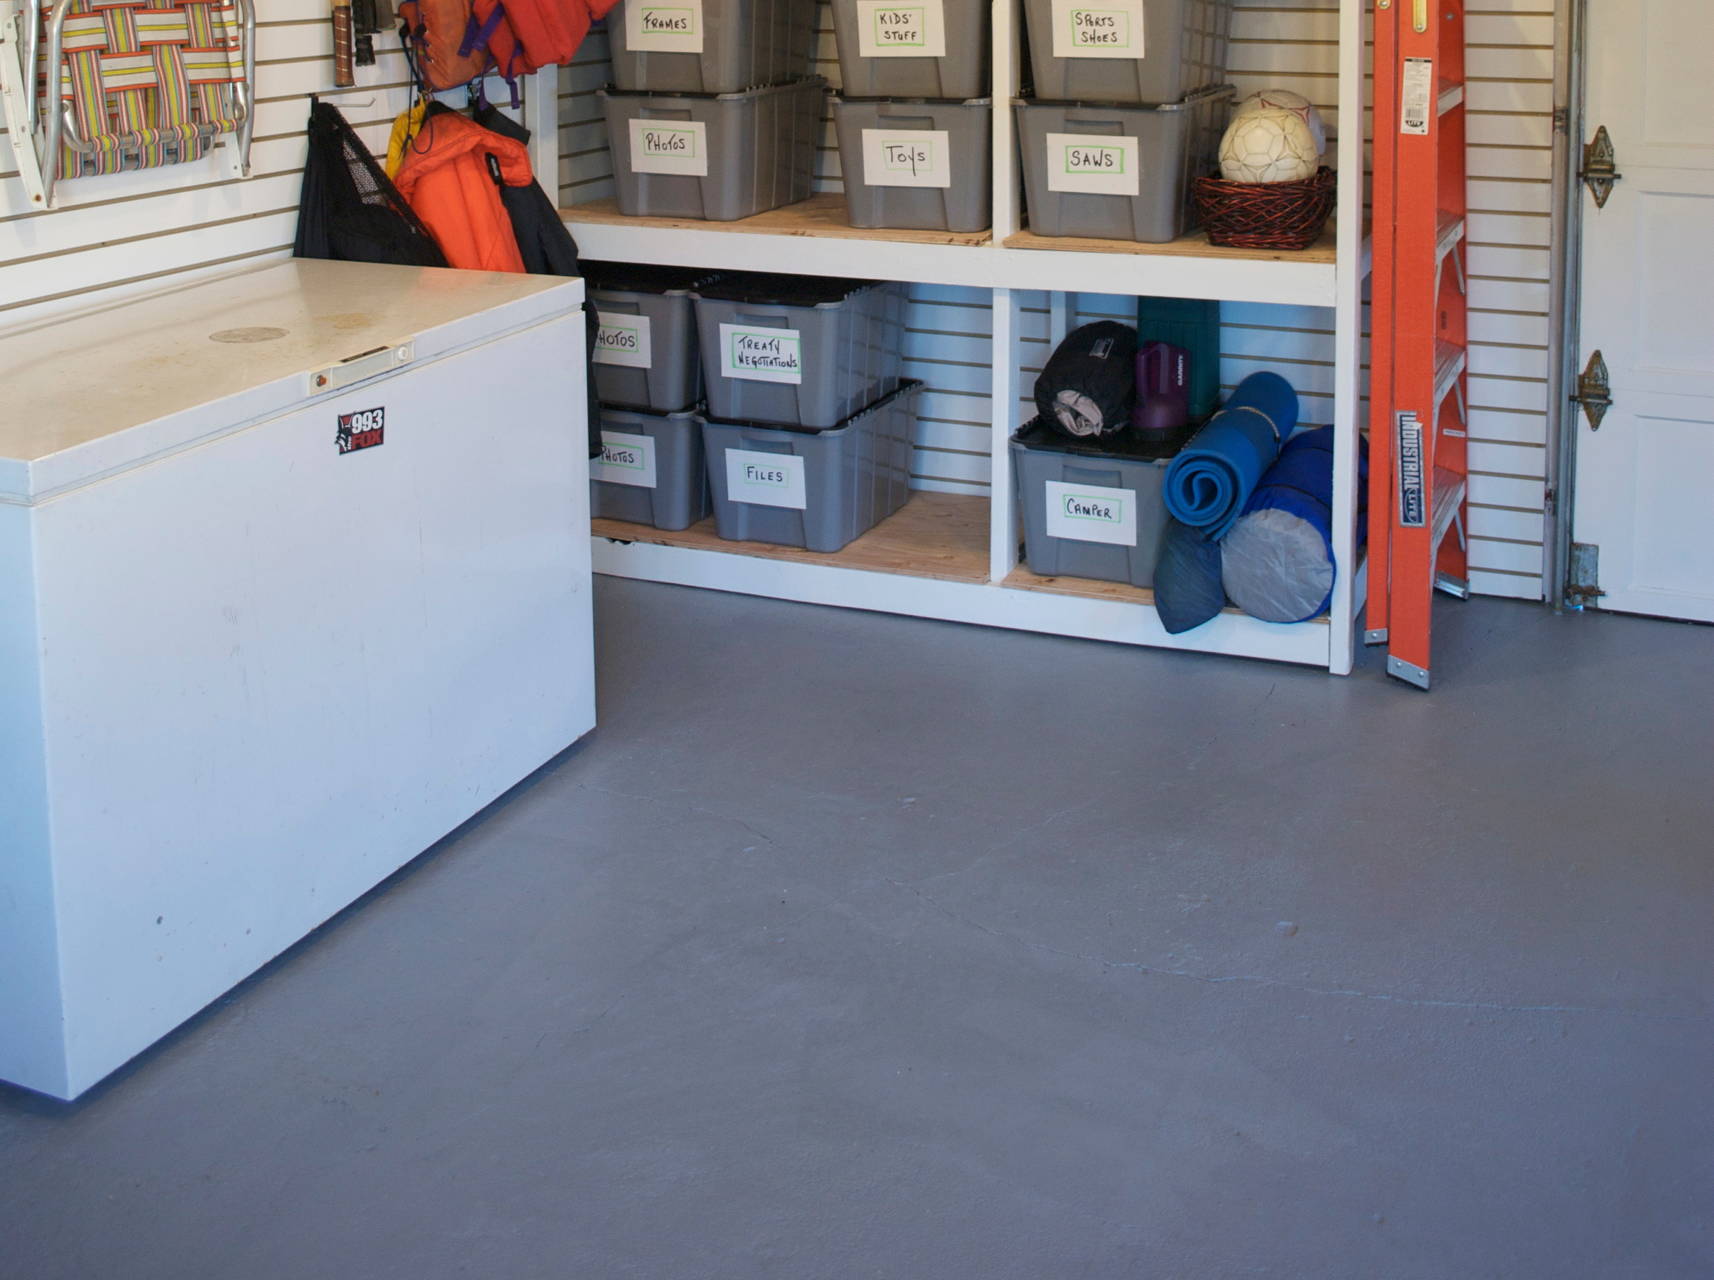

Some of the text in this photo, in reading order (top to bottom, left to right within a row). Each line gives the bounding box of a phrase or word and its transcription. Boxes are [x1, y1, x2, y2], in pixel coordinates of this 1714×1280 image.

[643, 11, 687, 30] FRAMES
[1075, 11, 1115, 27] SPORTS
[884, 30, 917, 41] STUFF
[1081, 28, 1118, 44] SHOES
[645, 132, 686, 151] PHOTOS
[1070, 148, 1114, 168] SAWS
[599, 331, 636, 348] HOTOS
[738, 335, 780, 354] TREATY
[738, 353, 798, 369] NEGOTIATIONS
[352, 409, 383, 434] 993
[352, 429, 382, 450] FOX
[1402, 416, 1419, 489] INDUSTRIAL
[746, 465, 784, 482] FILES
[1066, 498, 1113, 519] CAMPER
